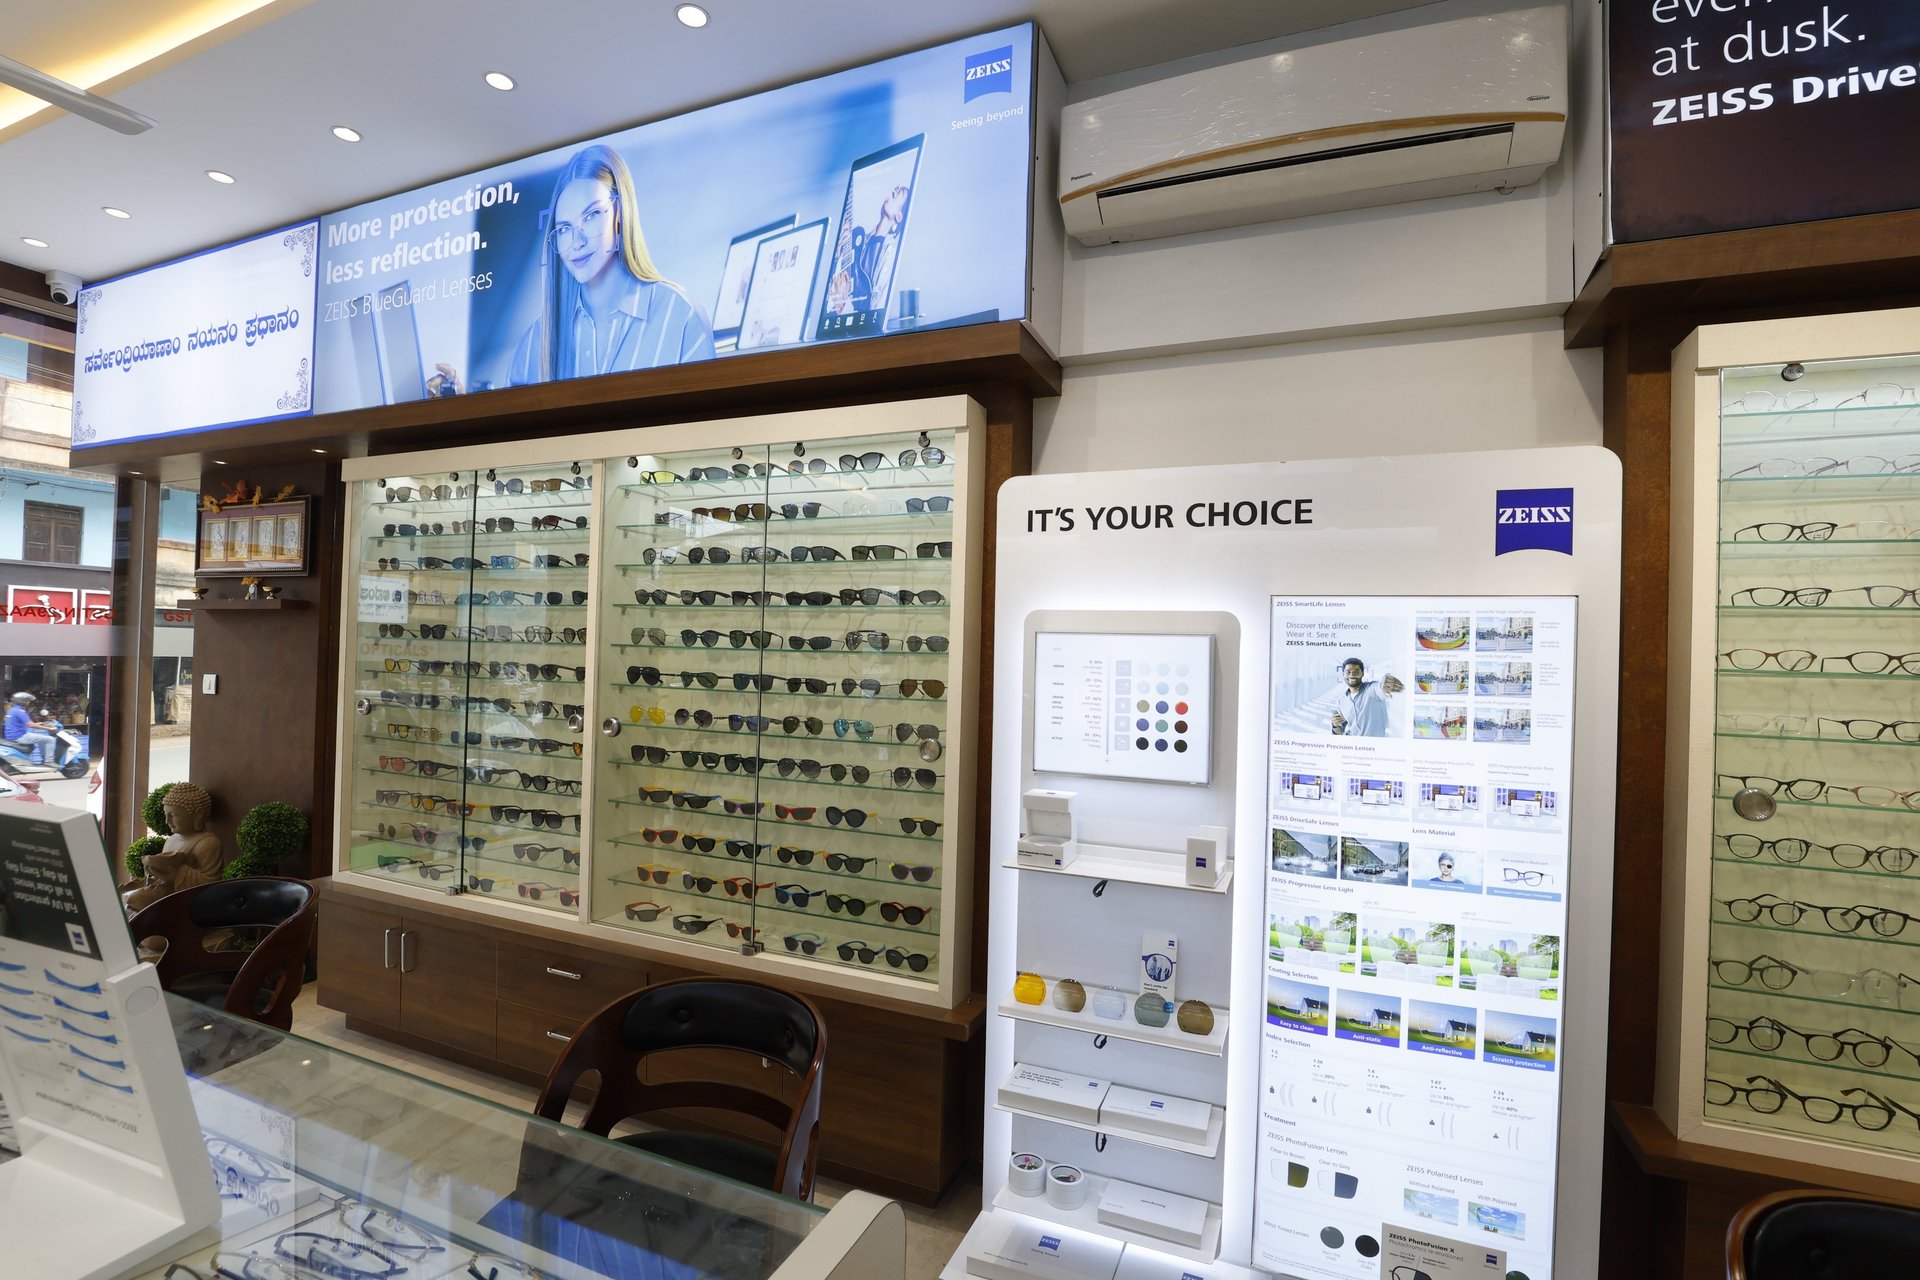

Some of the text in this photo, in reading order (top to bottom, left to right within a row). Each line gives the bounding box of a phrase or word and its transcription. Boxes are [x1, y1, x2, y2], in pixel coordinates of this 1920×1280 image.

[1652, 0, 1771, 24] ev
[1652, 6, 1866, 77] at dusk.
[966, 58, 1011, 81] ZEISS
[1652, 64, 1920, 126] ZEISS Drive
[951, 105, 1024, 130] Seeing beyond
[328, 180, 520, 248] More protection,
[326, 230, 487, 285] less reflection.
[324, 271, 493, 322] ZEISS BlueGuard Lenses
[1026, 498, 1314, 533] IT'S YOUR CHOICE
[1499, 504, 1572, 525] ZEISS
[1318, 622, 1330, 630] the
[1290, 816, 1318, 825] DriveSafe
[1288, 880, 1321, 889] Progressive
[1269, 965, 1318, 980] Coating Selection
[1266, 1032, 1311, 1048] Index Selection
[1353, 1034, 1382, 1043] Anti-static
[1422, 1045, 1462, 1056] Anti-reflective
[1492, 1056, 1546, 1069] Scratch protection
[1264, 1112, 1296, 1126] Treatment
[1268, 1131, 1348, 1156] ZEISS PhotoFusion Lenses
[1319, 1158, 1331, 1166] Clear
[1406, 1165, 1483, 1186] ZEISS Polarised Lenses
[1432, 1184, 1455, 1194] Polarised
[1478, 1194, 1517, 1207] With Polarised
[1389, 1232, 1406, 1242] ZEISS
[1408, 1238, 1448, 1252] PhotoFusion
